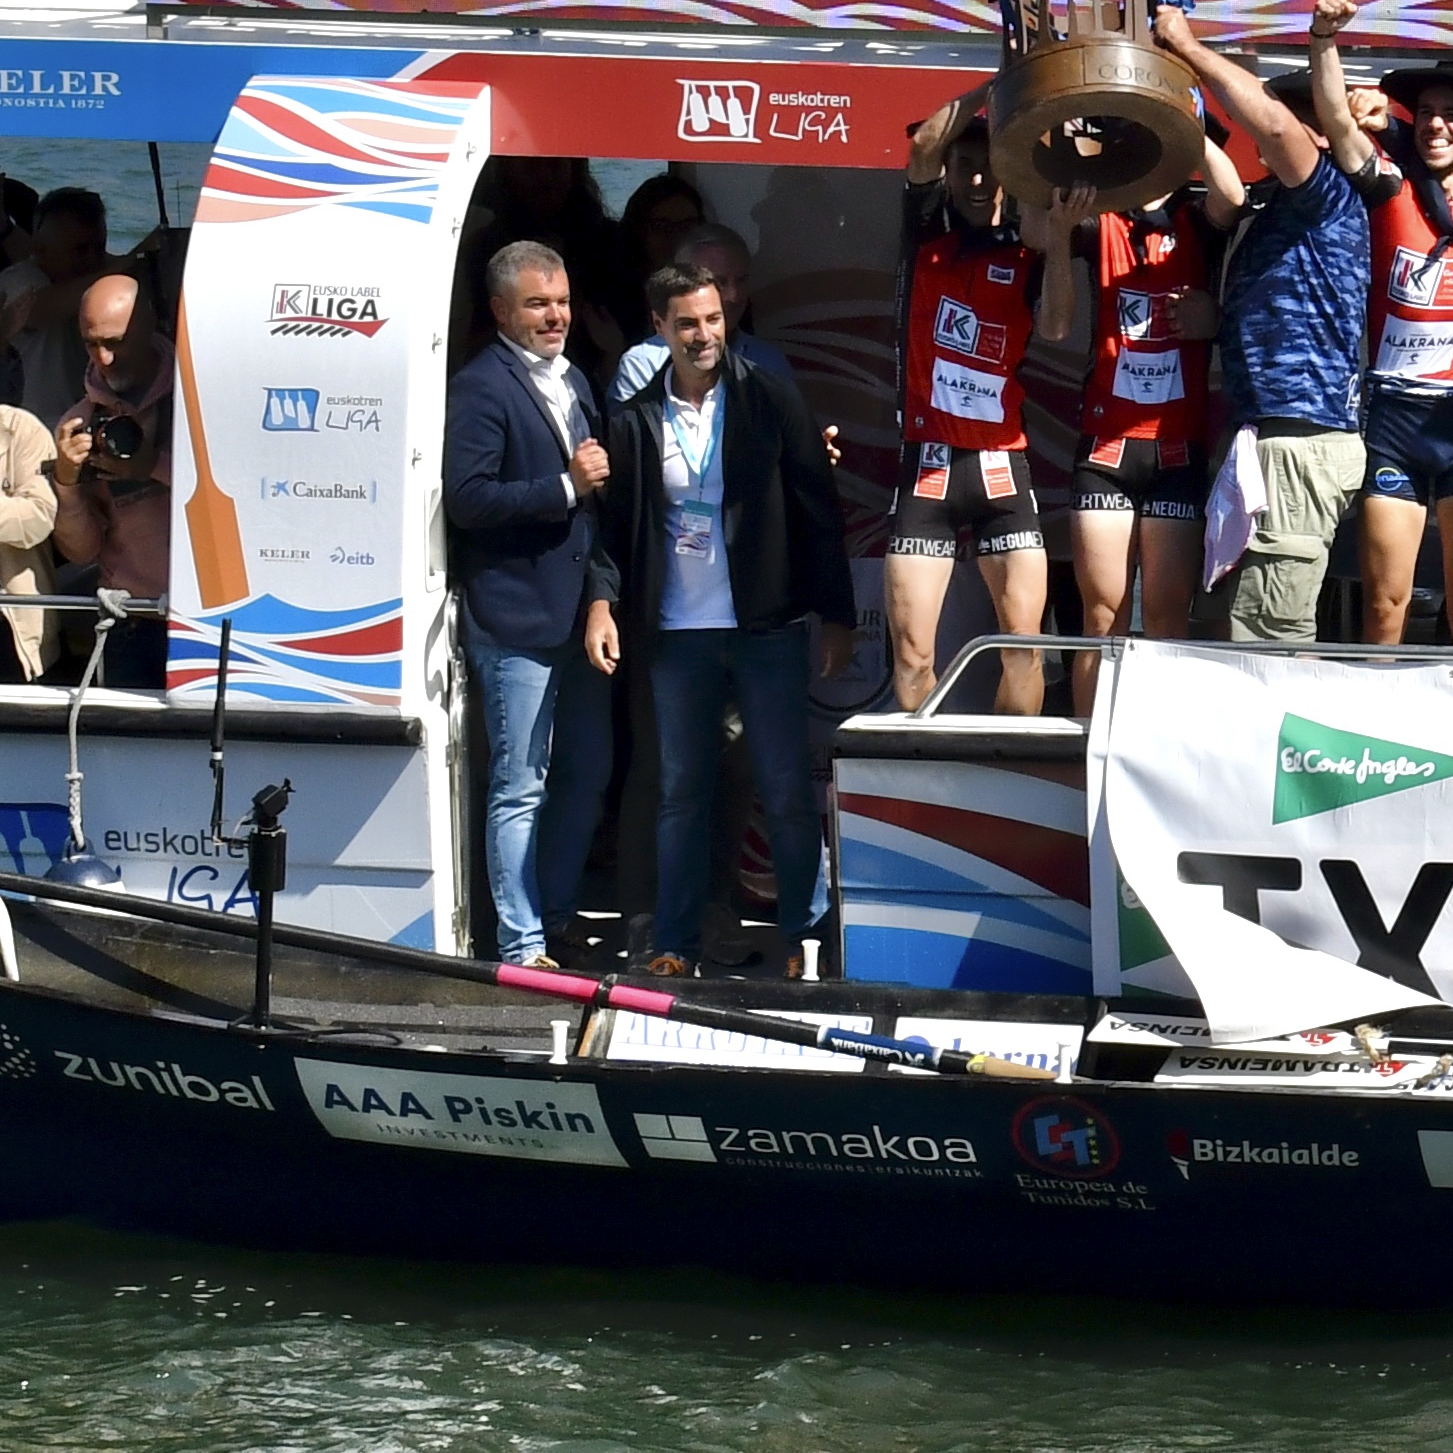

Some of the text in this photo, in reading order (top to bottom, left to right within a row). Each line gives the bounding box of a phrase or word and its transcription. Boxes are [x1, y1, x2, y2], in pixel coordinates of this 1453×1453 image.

[71, 98, 105, 110] 1872
[769, 91, 851, 108] euskotren
[768, 110, 851, 144] LIGA
[313, 285, 382, 299] EUSKO LABEL
[310, 297, 379, 320] LIGA
[326, 394, 383, 408] euskotren
[325, 410, 383, 433] LIGA
[292, 481, 367, 501] CaixaBank
[259, 547, 311, 561] KELER
[346, 551, 375, 566] eitb
[1281, 747, 1301, 773] El
[1304, 750, 1356, 775] Corte
[53, 1050, 276, 1113] zunibal
[323, 1082, 596, 1136] AAA Piskin
[376, 1121, 546, 1150] INVESTMENTS
[714, 1124, 979, 1165] zamakoa
[1193, 1139, 1361, 1168] Bizkaialde
[1015, 1173, 1148, 1195] Europea de
[1021, 1190, 1110, 1208] Tunidos
